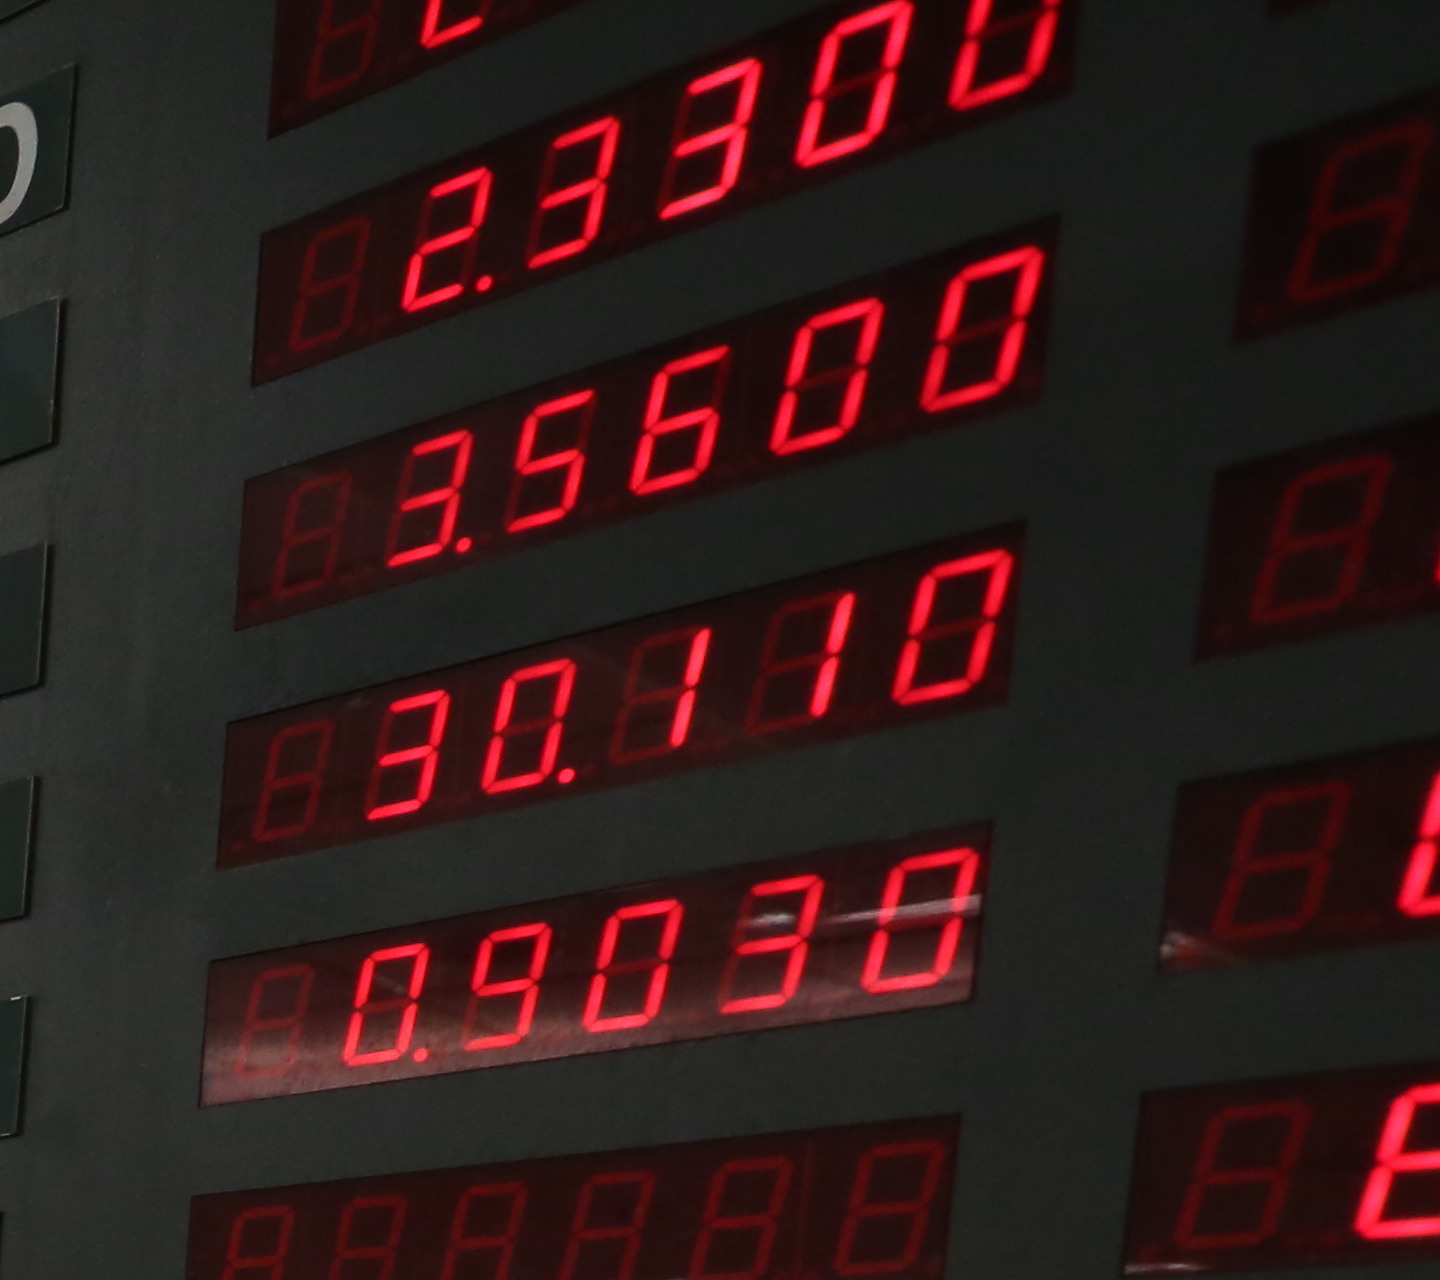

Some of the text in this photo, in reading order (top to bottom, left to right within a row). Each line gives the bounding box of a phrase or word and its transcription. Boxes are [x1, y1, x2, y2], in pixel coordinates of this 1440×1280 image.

[386, 245, 1045, 568] 3.5600
[367, 549, 1014, 819] 30.110
[342, 846, 980, 1068] 0.9030
